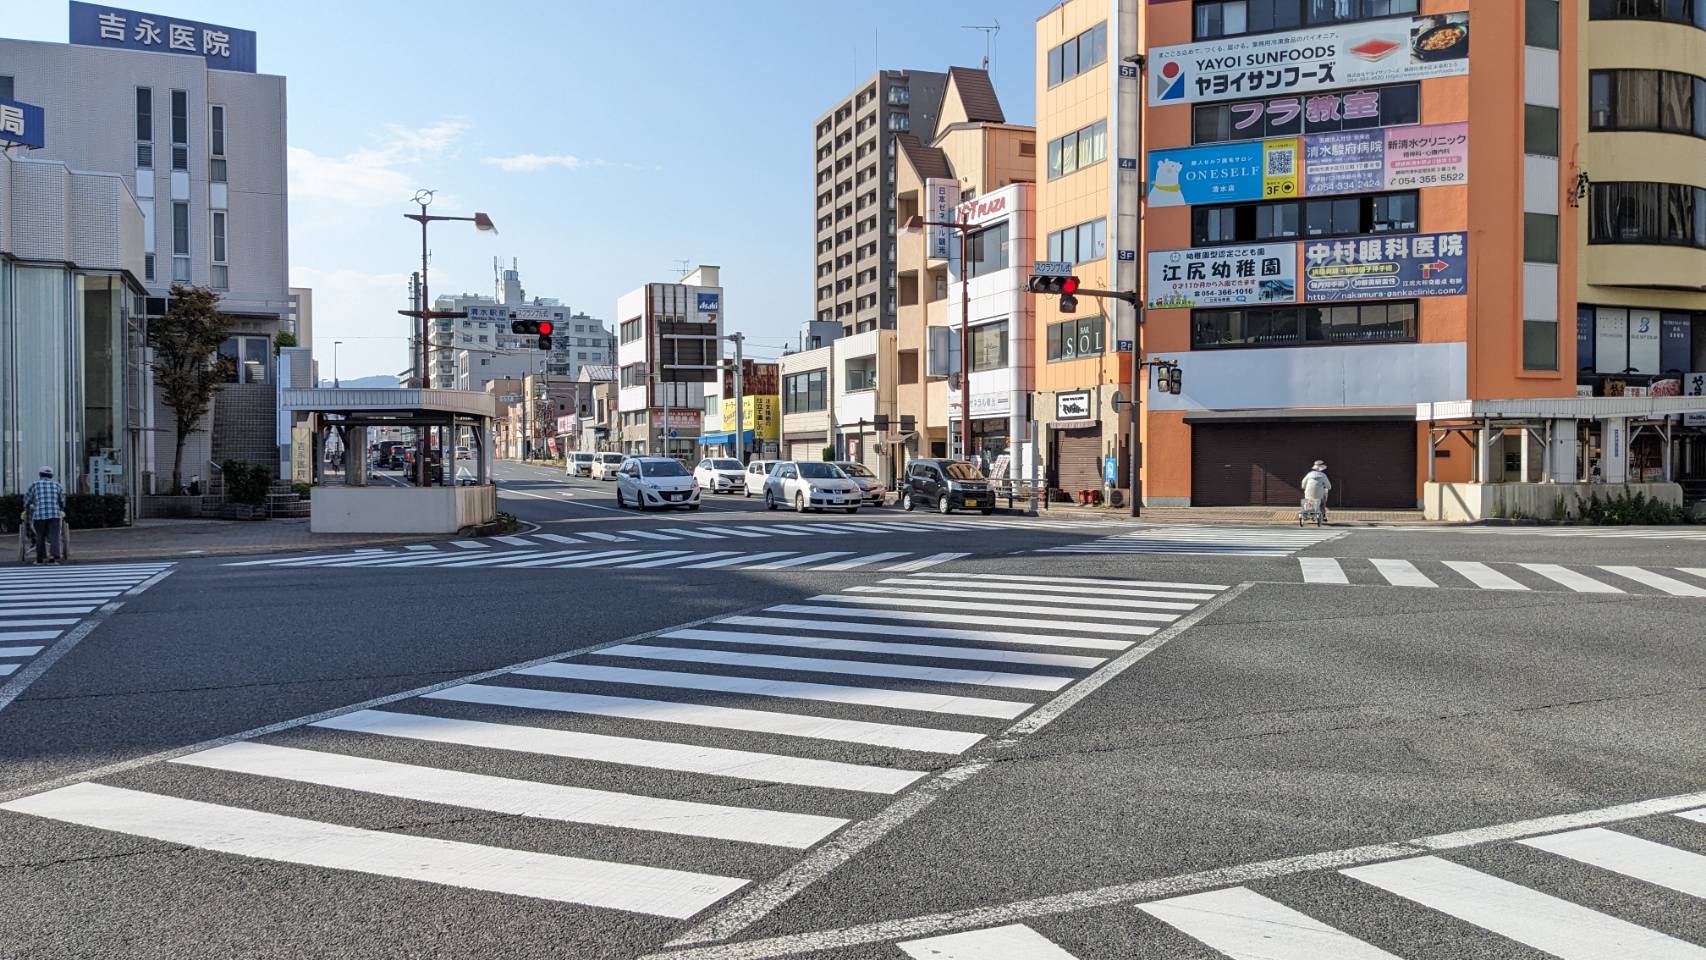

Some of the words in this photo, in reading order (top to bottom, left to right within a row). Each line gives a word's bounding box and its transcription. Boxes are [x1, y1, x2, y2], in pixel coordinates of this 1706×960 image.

[98, 13, 231, 57] 吉永医院
[1196, 56, 1241, 71] YAYOI
[1246, 45, 1336, 66] SUNFOODS
[1121, 67, 1135, 77] 5F
[1195, 61, 1336, 96] ヤヨイサンフーズ
[1231, 91, 1379, 130] フラ教室
[0, 104, 25, 136] 局
[1307, 140, 1383, 158] 清水駿府病院
[1388, 135, 1466, 150] 新清水クリニック
[1121, 159, 1133, 169] 4F
[1186, 166, 1260, 181] ONESELF
[1266, 186, 1280, 195] 3F
[978, 196, 1006, 217] PLAZA
[1120, 251, 1133, 260] 3F
[1308, 234, 1463, 264] 中村眼科医院
[1035, 262, 1071, 273] スクランブル式
[1163, 257, 1281, 281] 江尻幼稚園
[1201, 288, 1253, 296] 054-366-1016
[699, 302, 718, 310] Asahi
[1066, 332, 1103, 355] SOL
[1121, 341, 1132, 350] 2F
